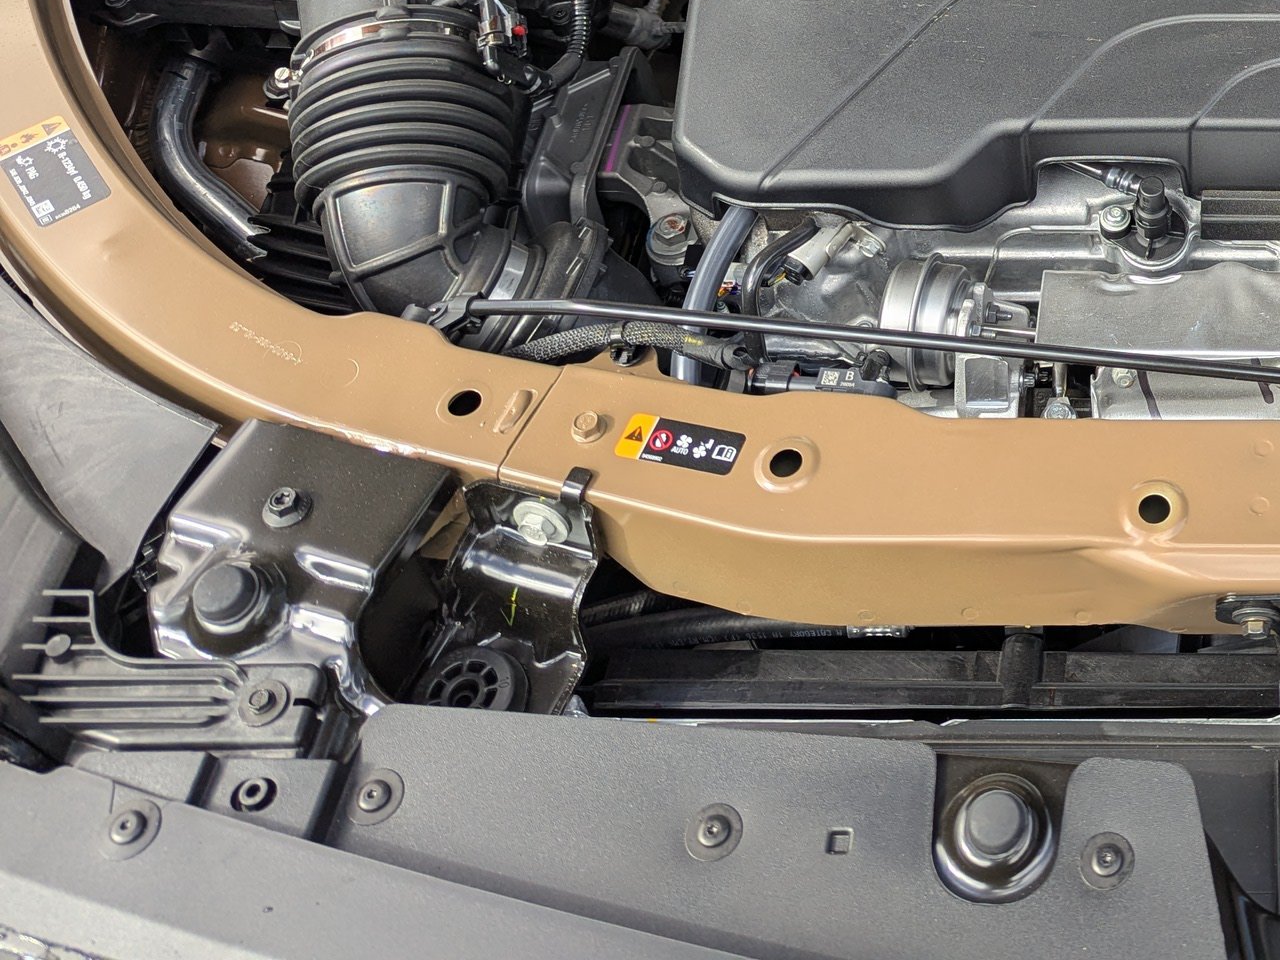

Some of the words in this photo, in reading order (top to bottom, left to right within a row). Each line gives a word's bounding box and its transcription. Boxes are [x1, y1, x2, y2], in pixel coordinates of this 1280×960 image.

[25, 165, 39, 180] PAG
[845, 371, 855, 381] B
[670, 447, 689, 455] AUTO
